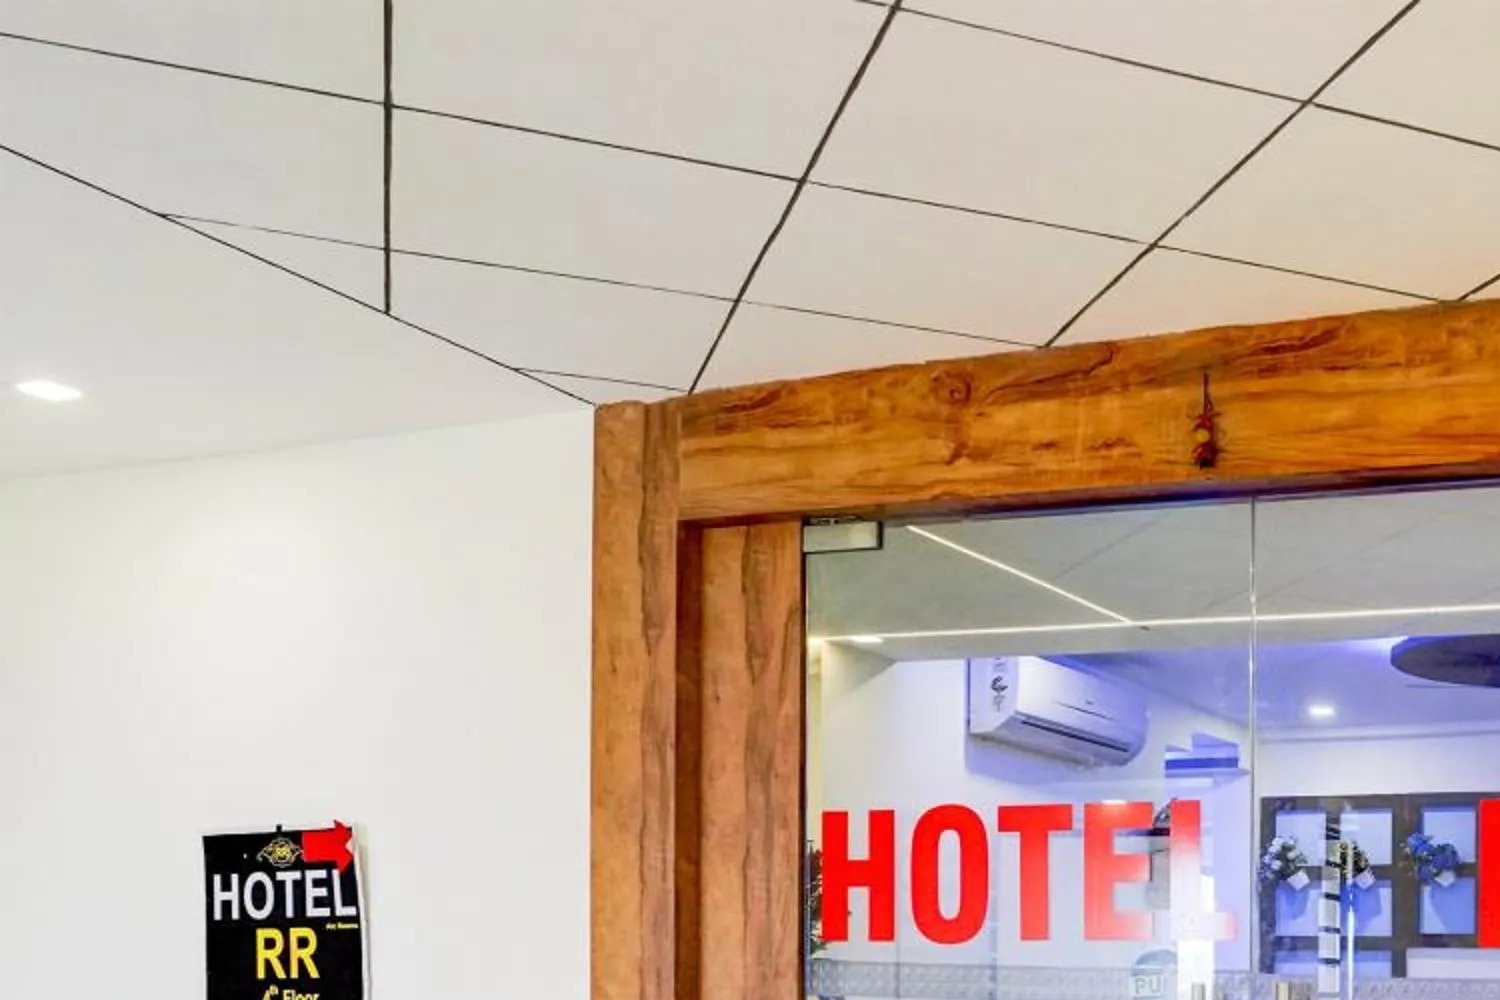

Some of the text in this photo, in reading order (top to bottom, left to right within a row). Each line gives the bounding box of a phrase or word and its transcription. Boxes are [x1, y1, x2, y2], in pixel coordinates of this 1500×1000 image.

[213, 870, 357, 920] HOTEL
[821, 800, 1238, 943] HOTEL
[256, 928, 320, 979] RR
